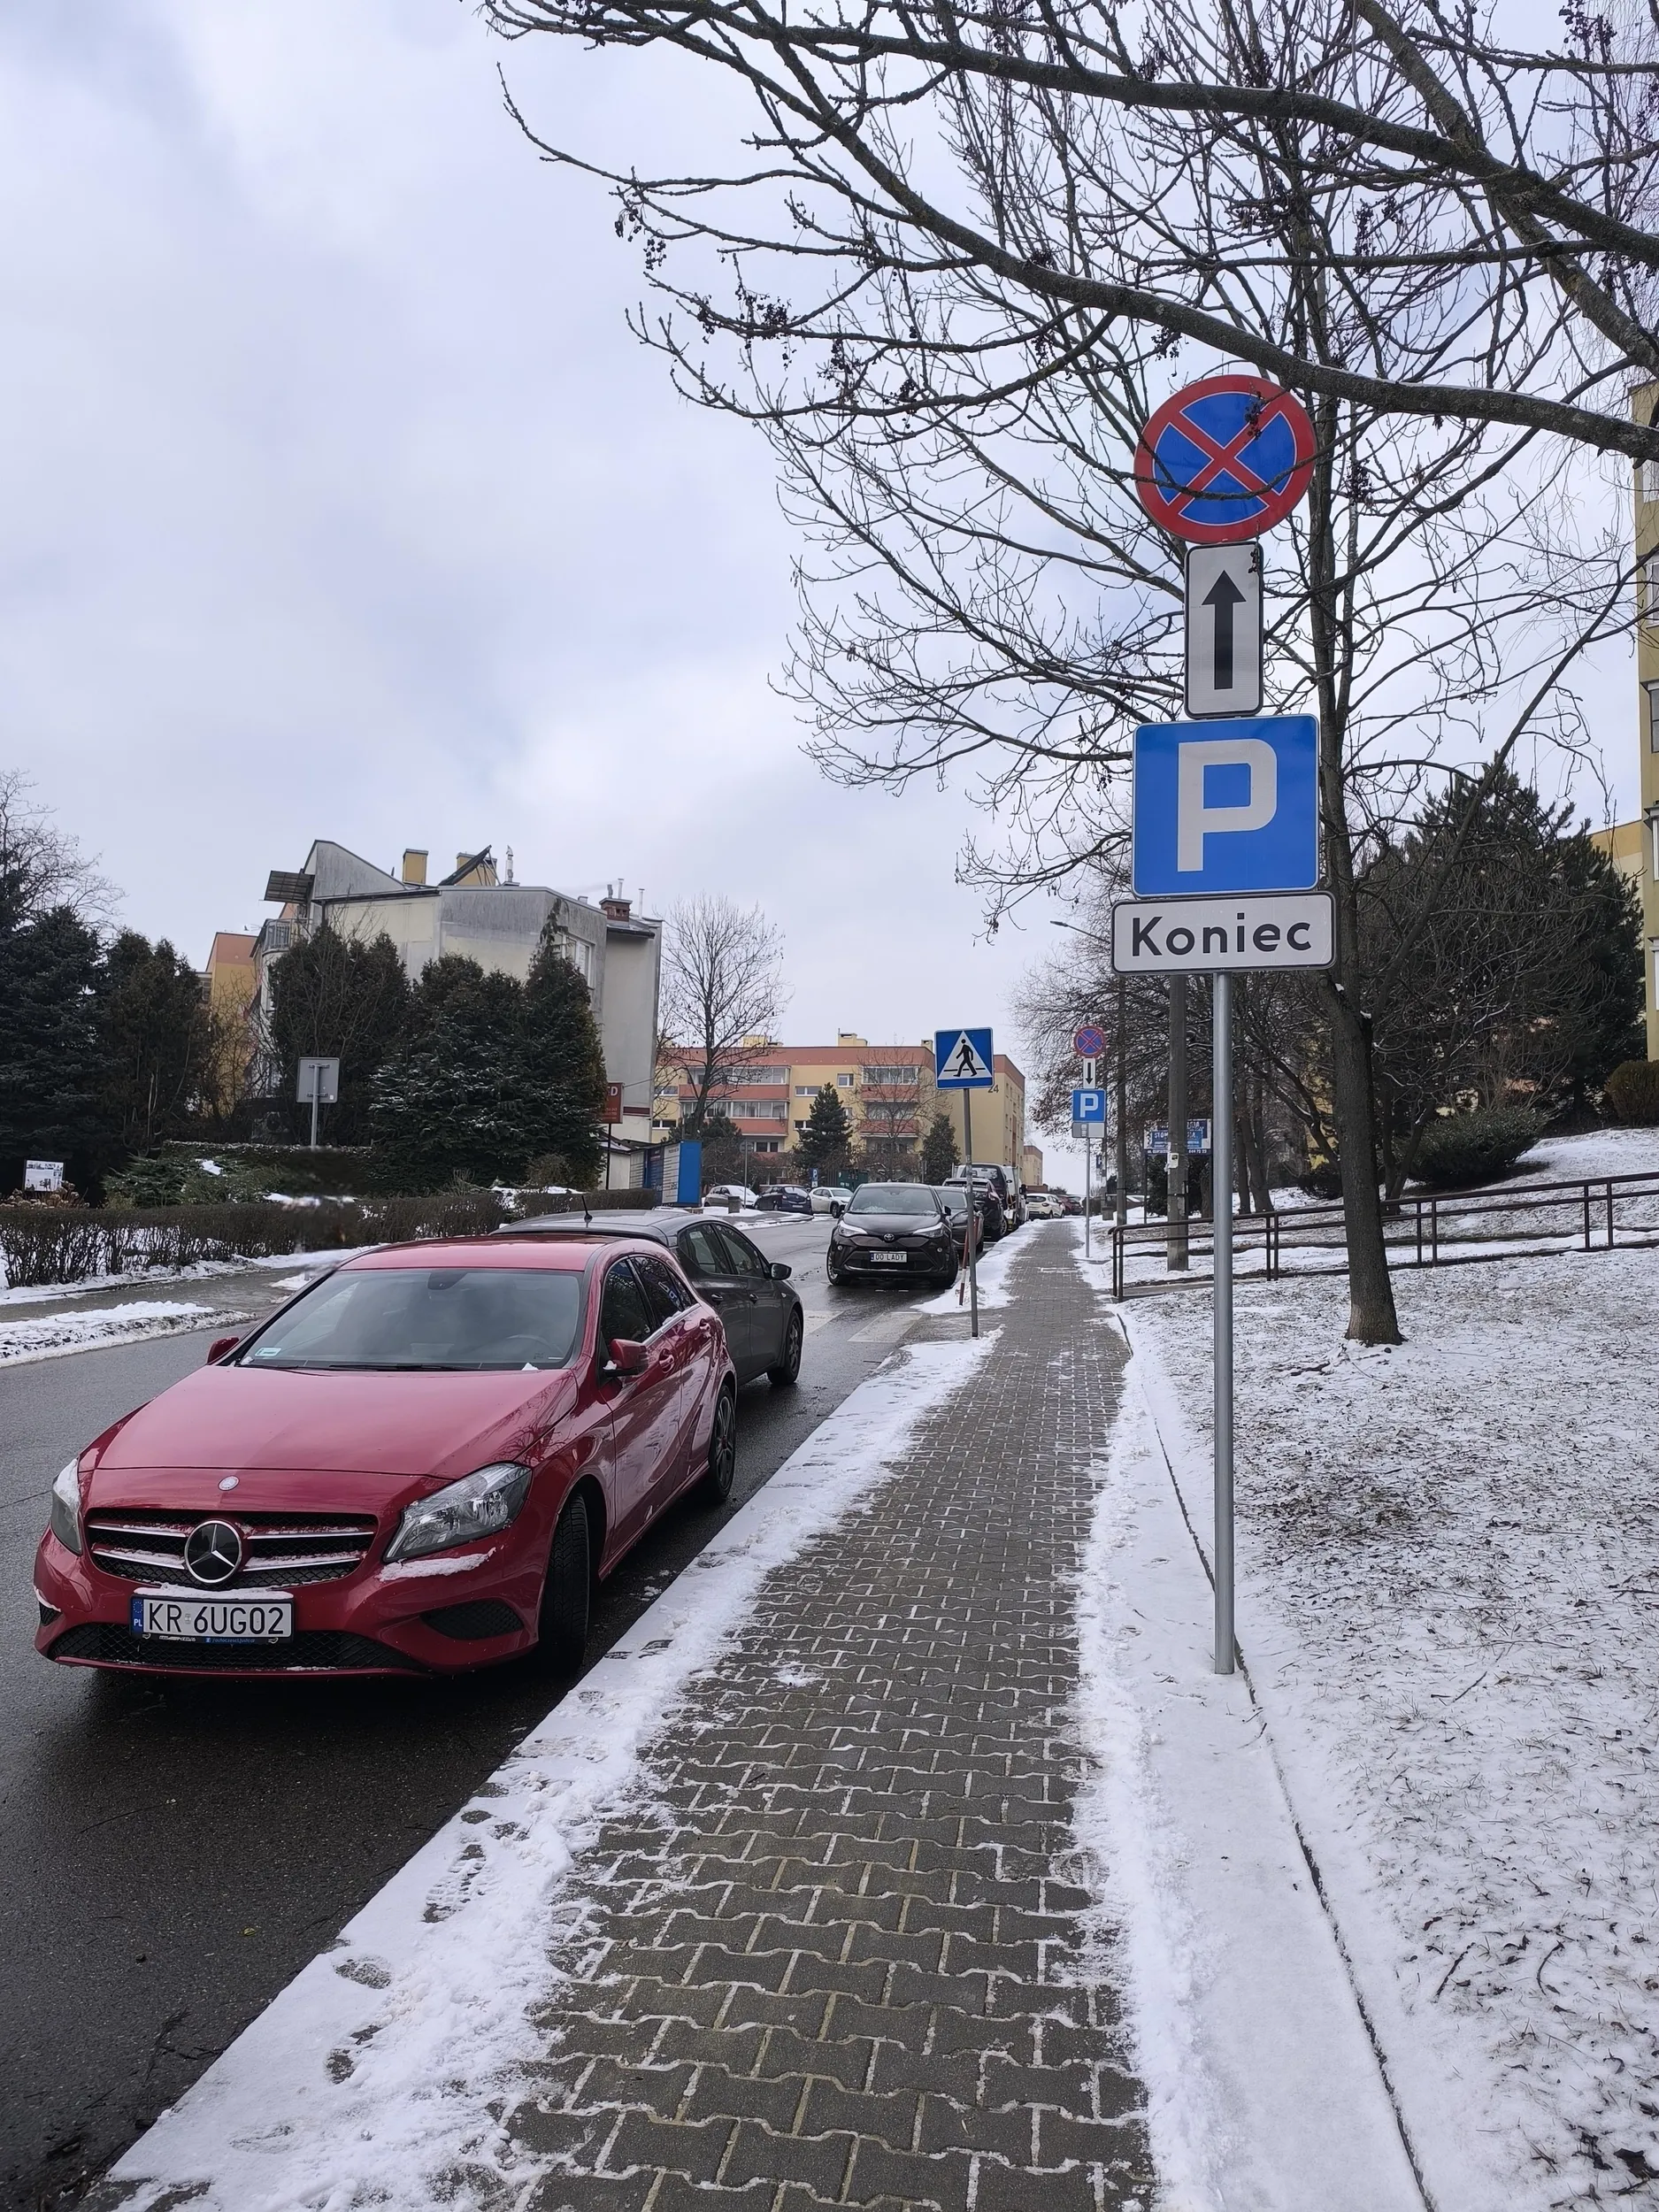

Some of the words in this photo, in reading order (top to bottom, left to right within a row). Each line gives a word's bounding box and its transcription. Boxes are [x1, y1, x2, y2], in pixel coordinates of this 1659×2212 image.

[1177, 738, 1278, 872] P
[1132, 912, 1312, 957] Koniec
[1079, 1093, 1099, 1118] P
[134, 1618, 143, 1627] PL
[149, 1602, 182, 1633] KR
[193, 1605, 284, 1635] 6UG02
